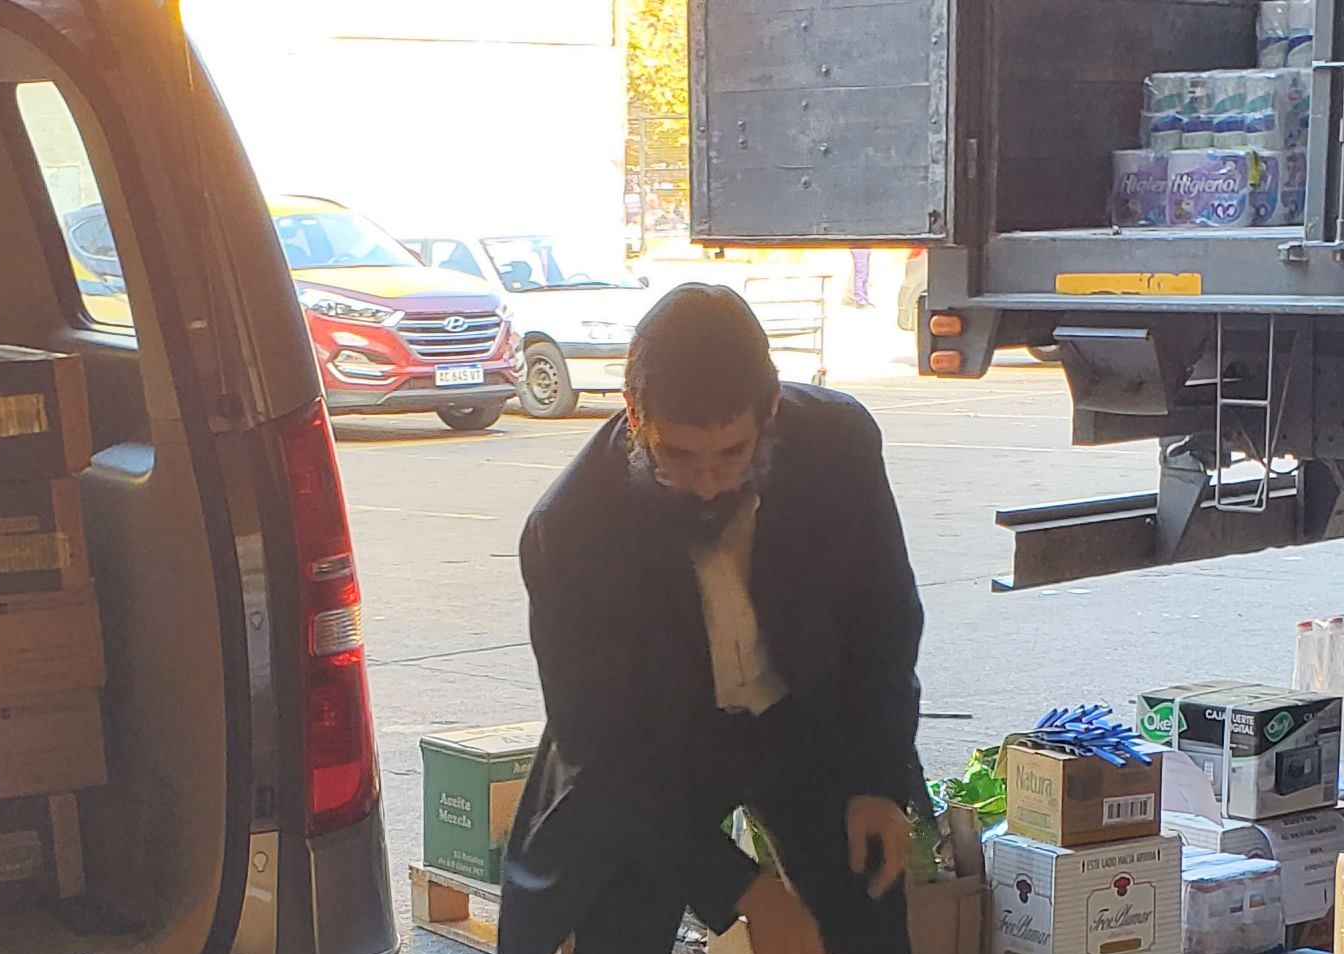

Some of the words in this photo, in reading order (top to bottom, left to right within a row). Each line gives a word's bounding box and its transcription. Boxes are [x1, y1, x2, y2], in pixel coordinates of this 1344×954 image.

[1121, 173, 1168, 197] Higien
[1173, 173, 1240, 197] Higienol
[1205, 709, 1227, 722] CAJA
[1232, 712, 1255, 725] UERTE
[1231, 723, 1255, 736] GITAL
[1016, 765, 1053, 797] Natura
[440, 792, 471, 811] Aceite
[438, 808, 472, 829] Mezcla
[1087, 859, 1100, 871] ESTE
[1101, 858, 1116, 869] LADO
